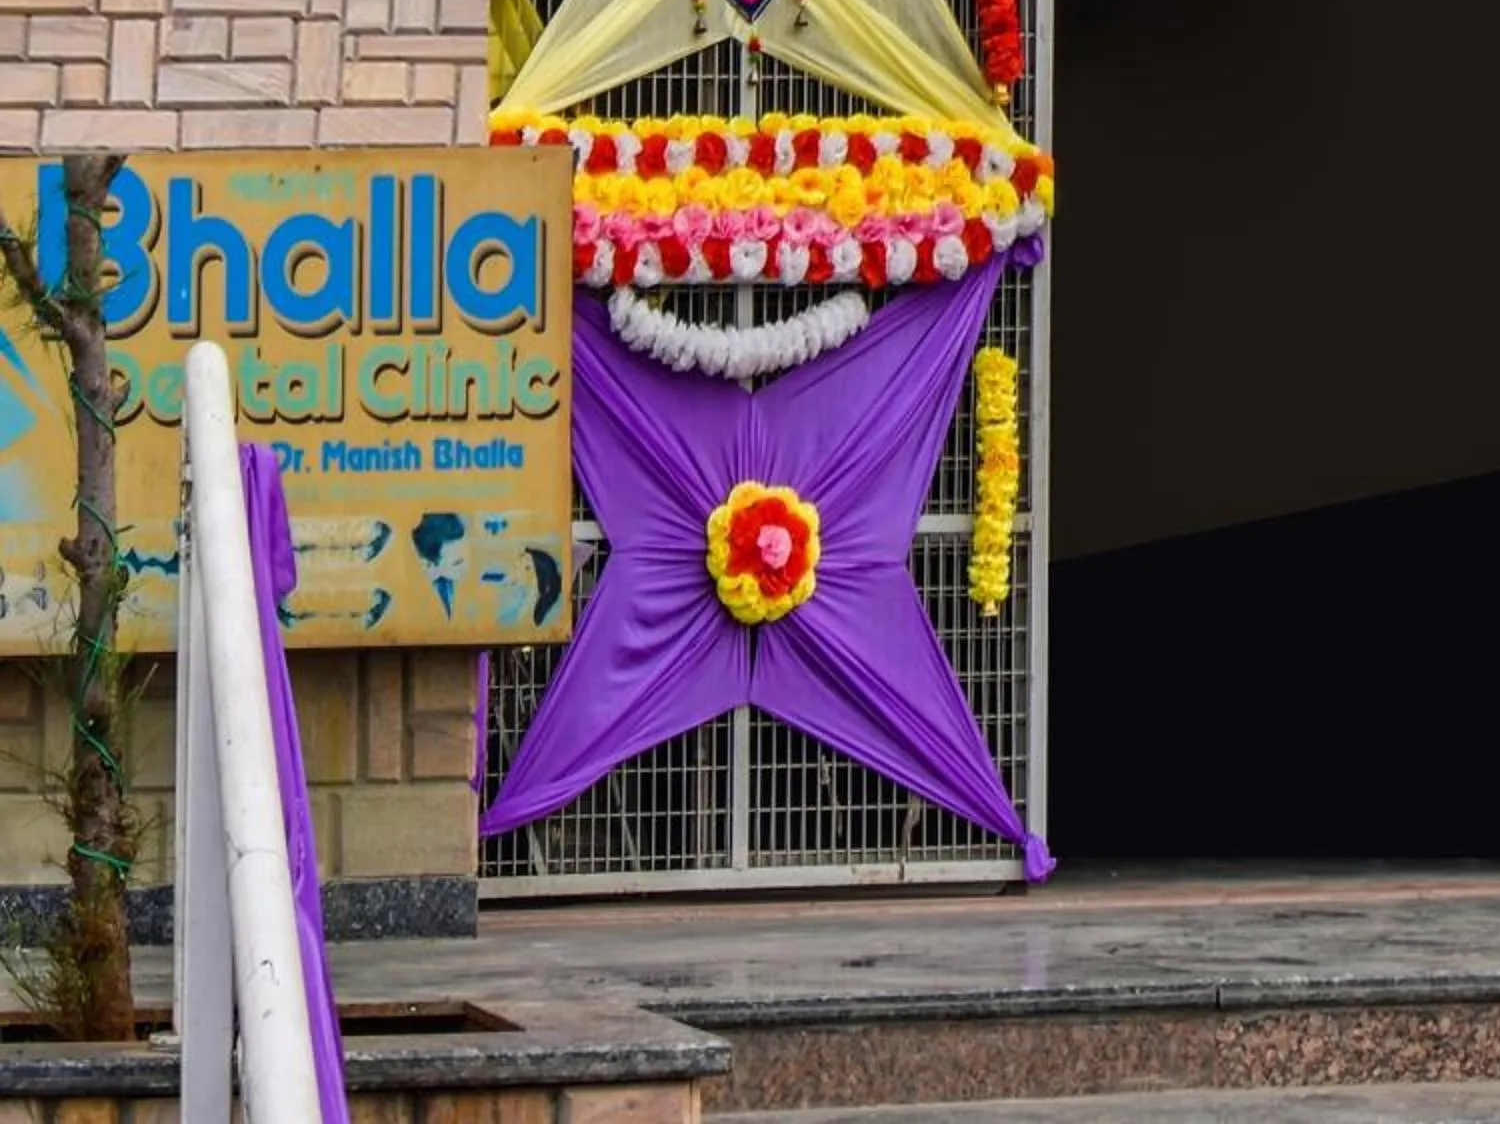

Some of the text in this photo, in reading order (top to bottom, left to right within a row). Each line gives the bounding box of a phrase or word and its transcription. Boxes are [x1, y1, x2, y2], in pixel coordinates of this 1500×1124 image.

[37, 162, 543, 332] Bhalla
[106, 339, 559, 422] Detal Clinic
[321, 439, 422, 473] Manish
[432, 436, 524, 470] Bhalla
